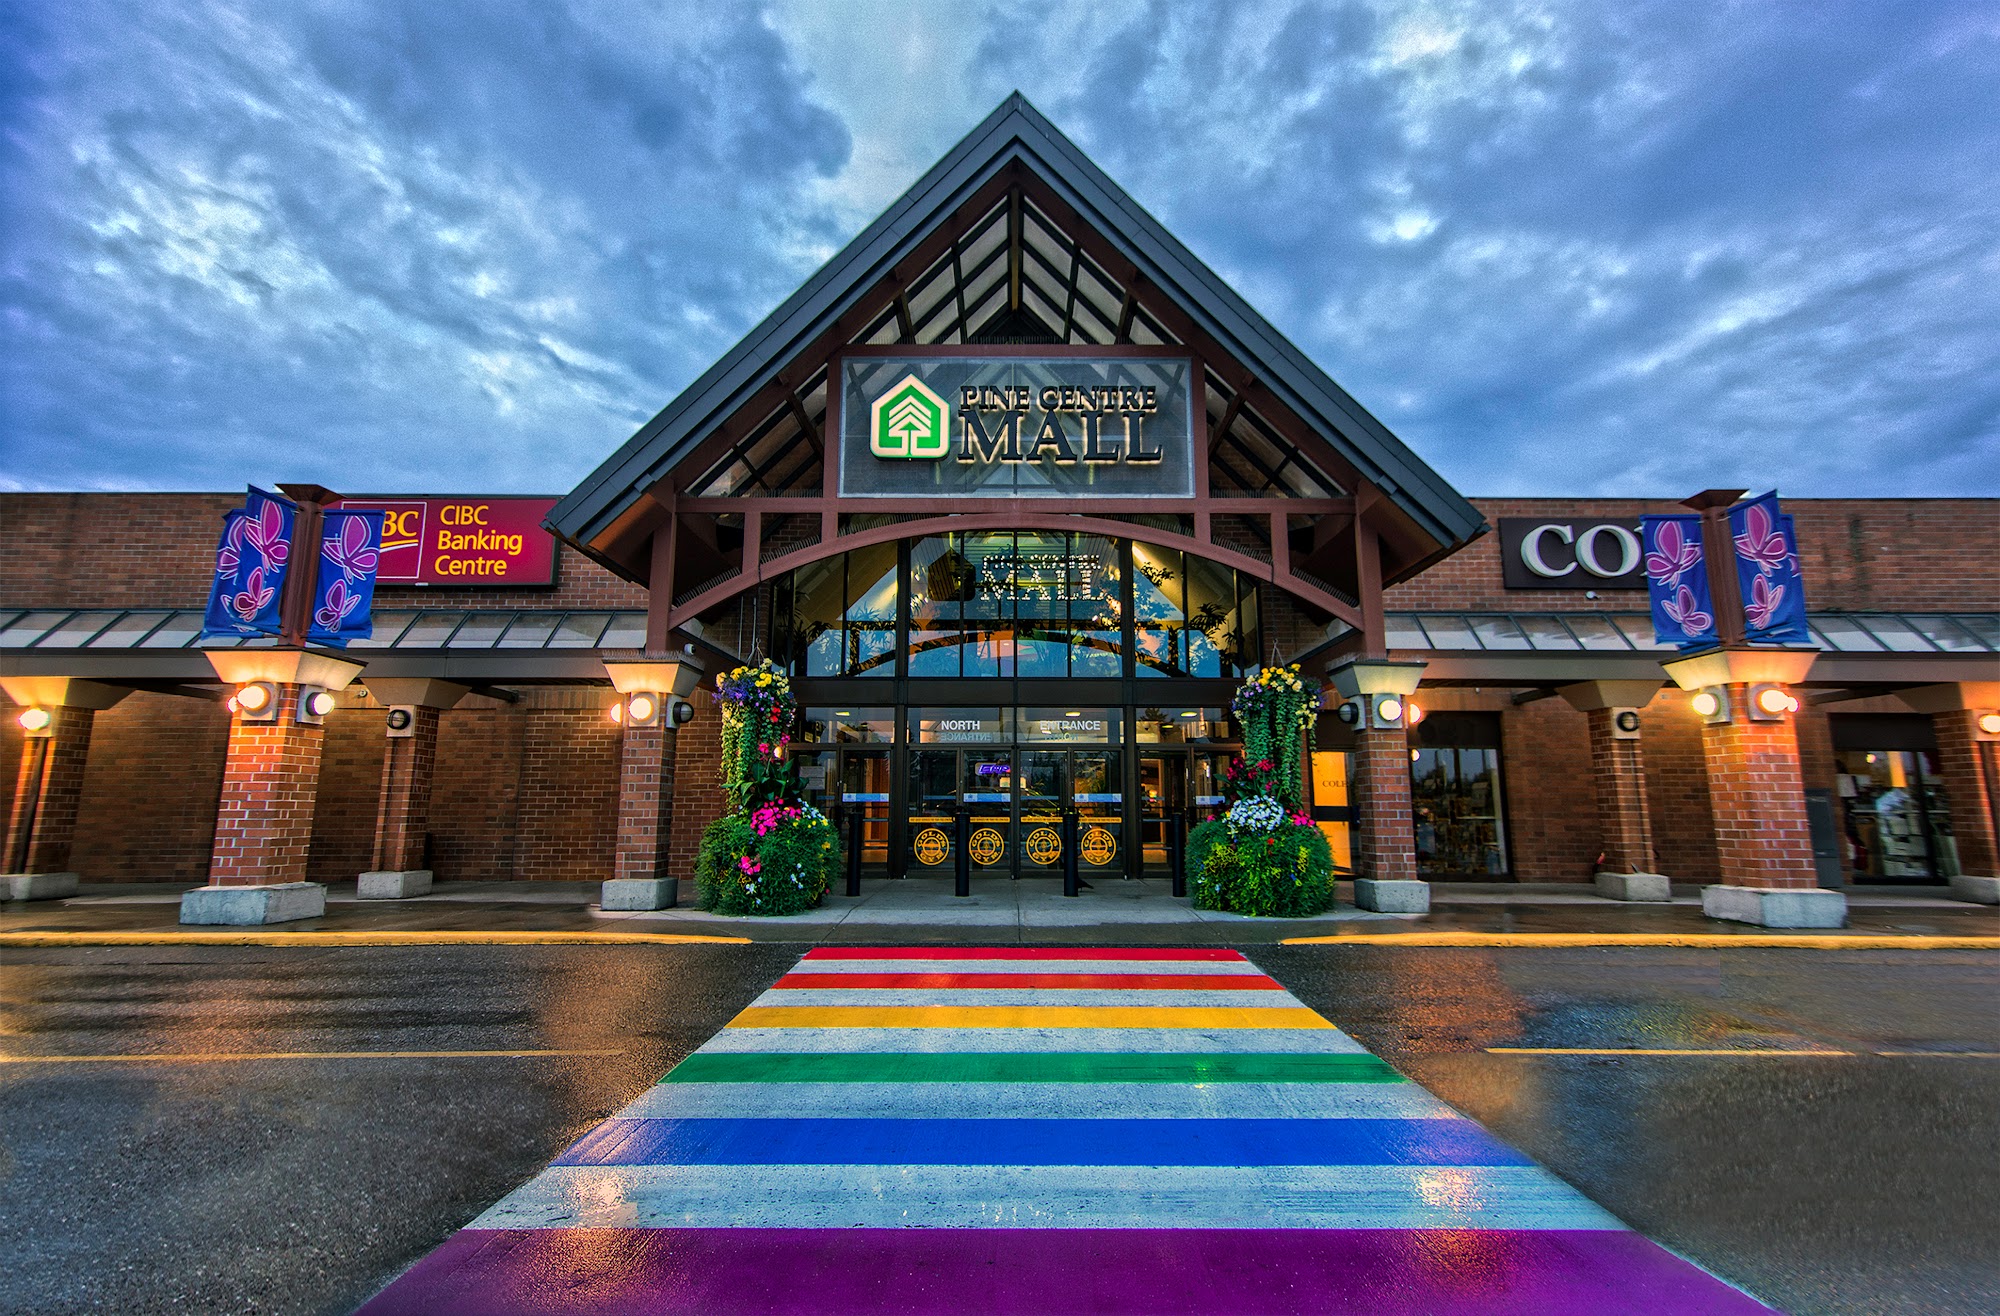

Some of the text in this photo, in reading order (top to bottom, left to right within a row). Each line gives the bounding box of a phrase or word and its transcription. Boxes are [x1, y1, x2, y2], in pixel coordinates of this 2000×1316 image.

[959, 385, 1157, 412] PINE CENTRE
[957, 409, 1163, 464] MALL
[439, 505, 489, 526] CIBC
[437, 529, 523, 556] Banking
[1520, 524, 1648, 578] CO
[434, 555, 507, 576] Centre
[941, 720, 1101, 731] NORTH ENTRANCE
